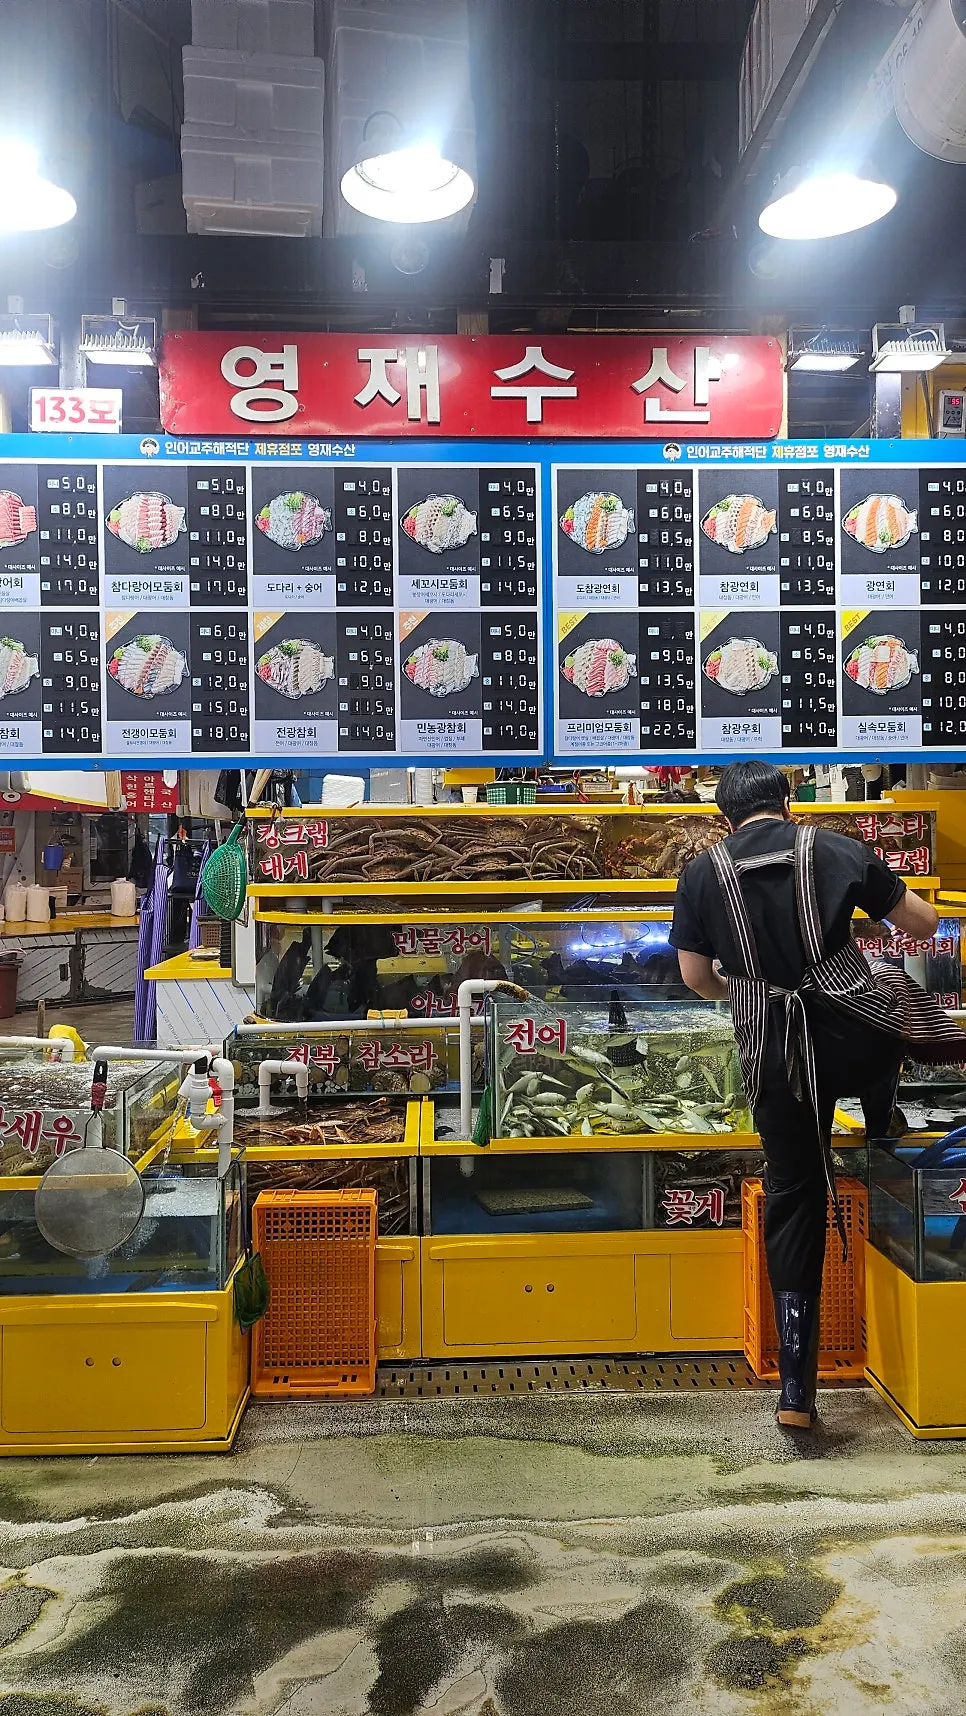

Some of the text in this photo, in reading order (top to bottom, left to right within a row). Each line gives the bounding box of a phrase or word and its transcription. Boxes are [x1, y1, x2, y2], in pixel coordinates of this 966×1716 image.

[221, 344, 721, 423] 영재수산
[165, 442, 355, 456] 인어교주해적단 제휴점포 영재수산
[687, 445, 870, 458] 인어교주해적단 제휴점포 영재수산
[111, 581, 183, 592] 참다랑어모둠회
[266, 582, 294, 593] 도다리
[304, 582, 323, 593] 숭어
[411, 579, 468, 590] 세꼬시모둠회
[576, 584, 620, 594] 도참광연회
[719, 581, 759, 593] 참광연회
[866, 580, 895, 592] 광연회
[560, 614, 579, 635] BEST
[843, 612, 862, 632] BEST
[121, 728, 177, 739] 전갱이모둠회
[276, 727, 317, 739] 전광참회
[416, 722, 466, 734] 민농광참회
[566, 722, 632, 733] 프리미엄모둠회
[721, 723, 761, 734] 참광우회
[857, 721, 906, 733] 실속모둠회
[856, 813, 928, 841] 랍스타
[257, 820, 328, 848] 킹크랩
[260, 850, 309, 881] 대게
[392, 926, 491, 958] 민물장어
[503, 1018, 567, 1056] 전어
[355, 1040, 439, 1072] 참소라
[0, 1106, 83, 1157] 새우
[662, 1188, 725, 1227] 꽃게
